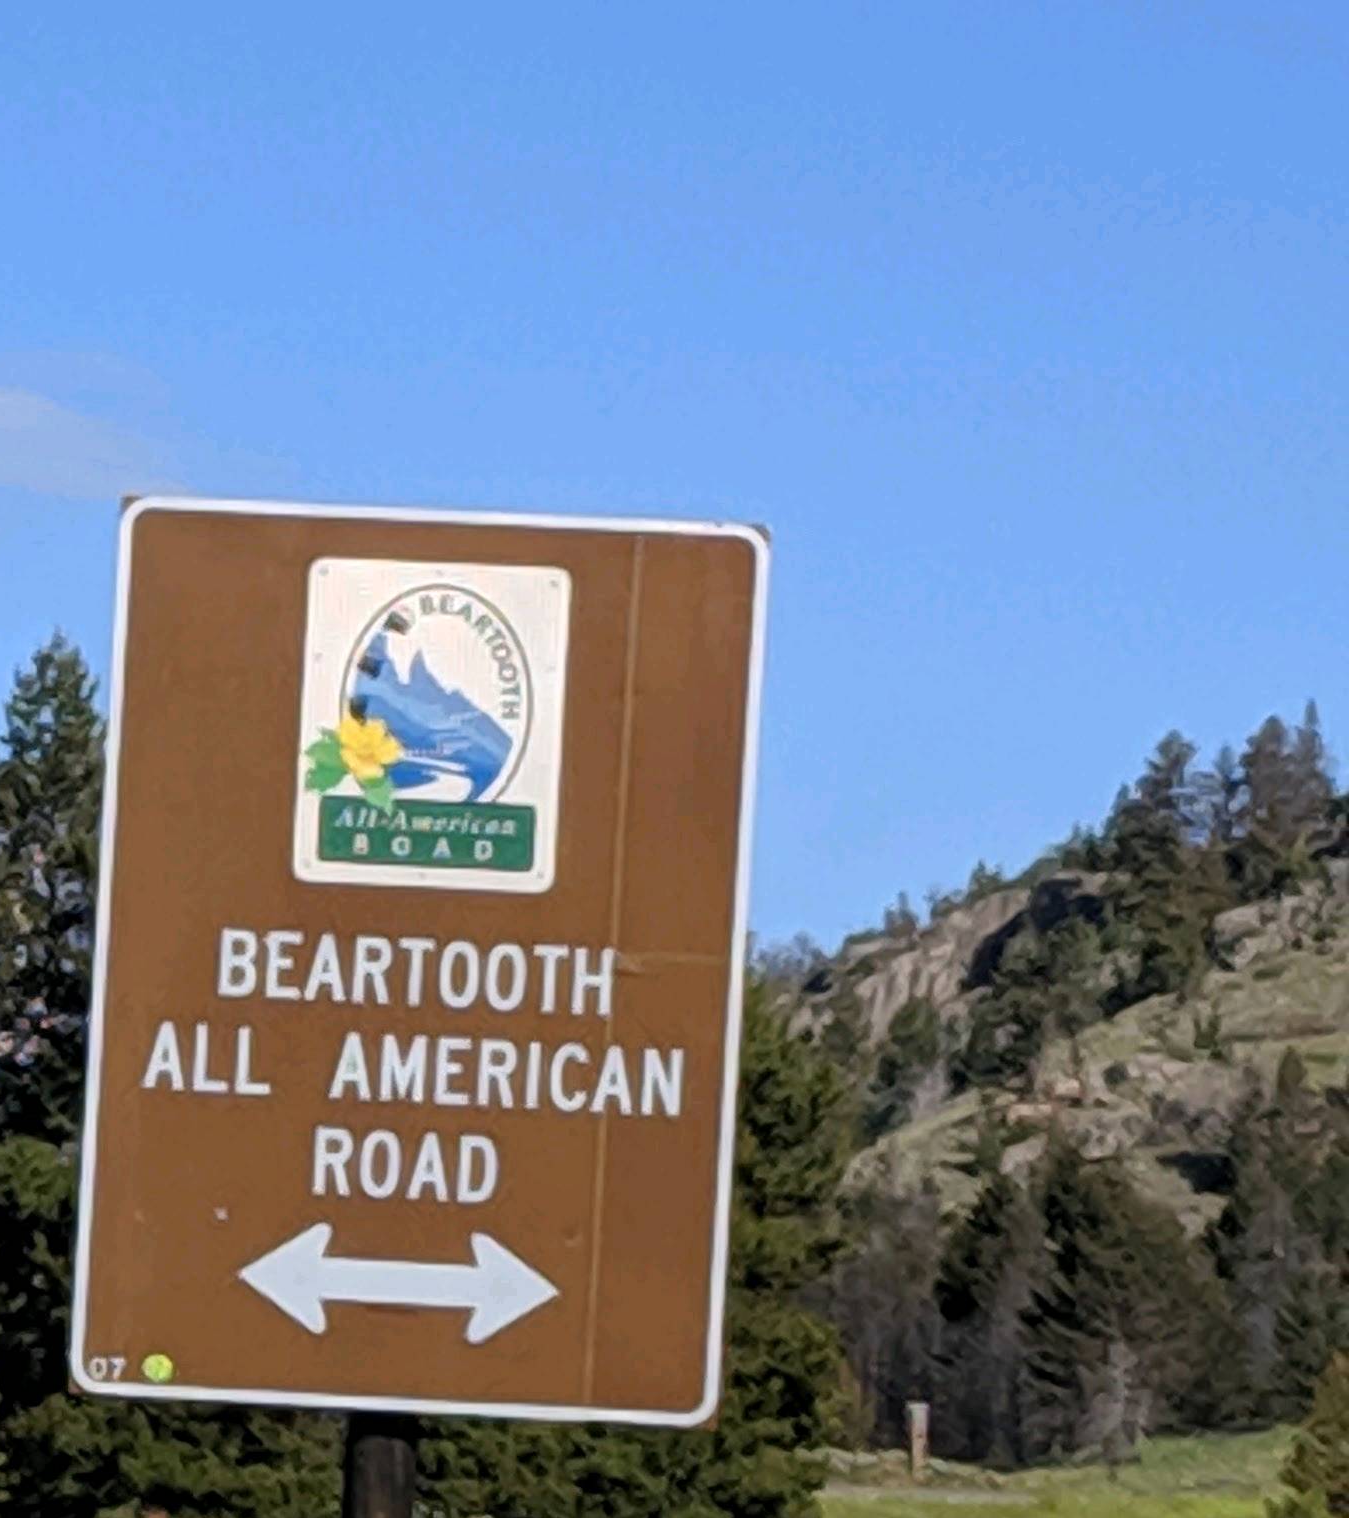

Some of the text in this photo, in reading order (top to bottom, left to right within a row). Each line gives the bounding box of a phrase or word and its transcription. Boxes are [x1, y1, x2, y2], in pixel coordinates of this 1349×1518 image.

[419, 594, 521, 719] BEARTOOTH
[353, 832, 494, 862] ROAD
[217, 928, 615, 1016] BEARTOOTH
[142, 1021, 684, 1117] ALL AMERICAN
[312, 1125, 499, 1204] ROAD
[89, 1356, 126, 1380] 07
